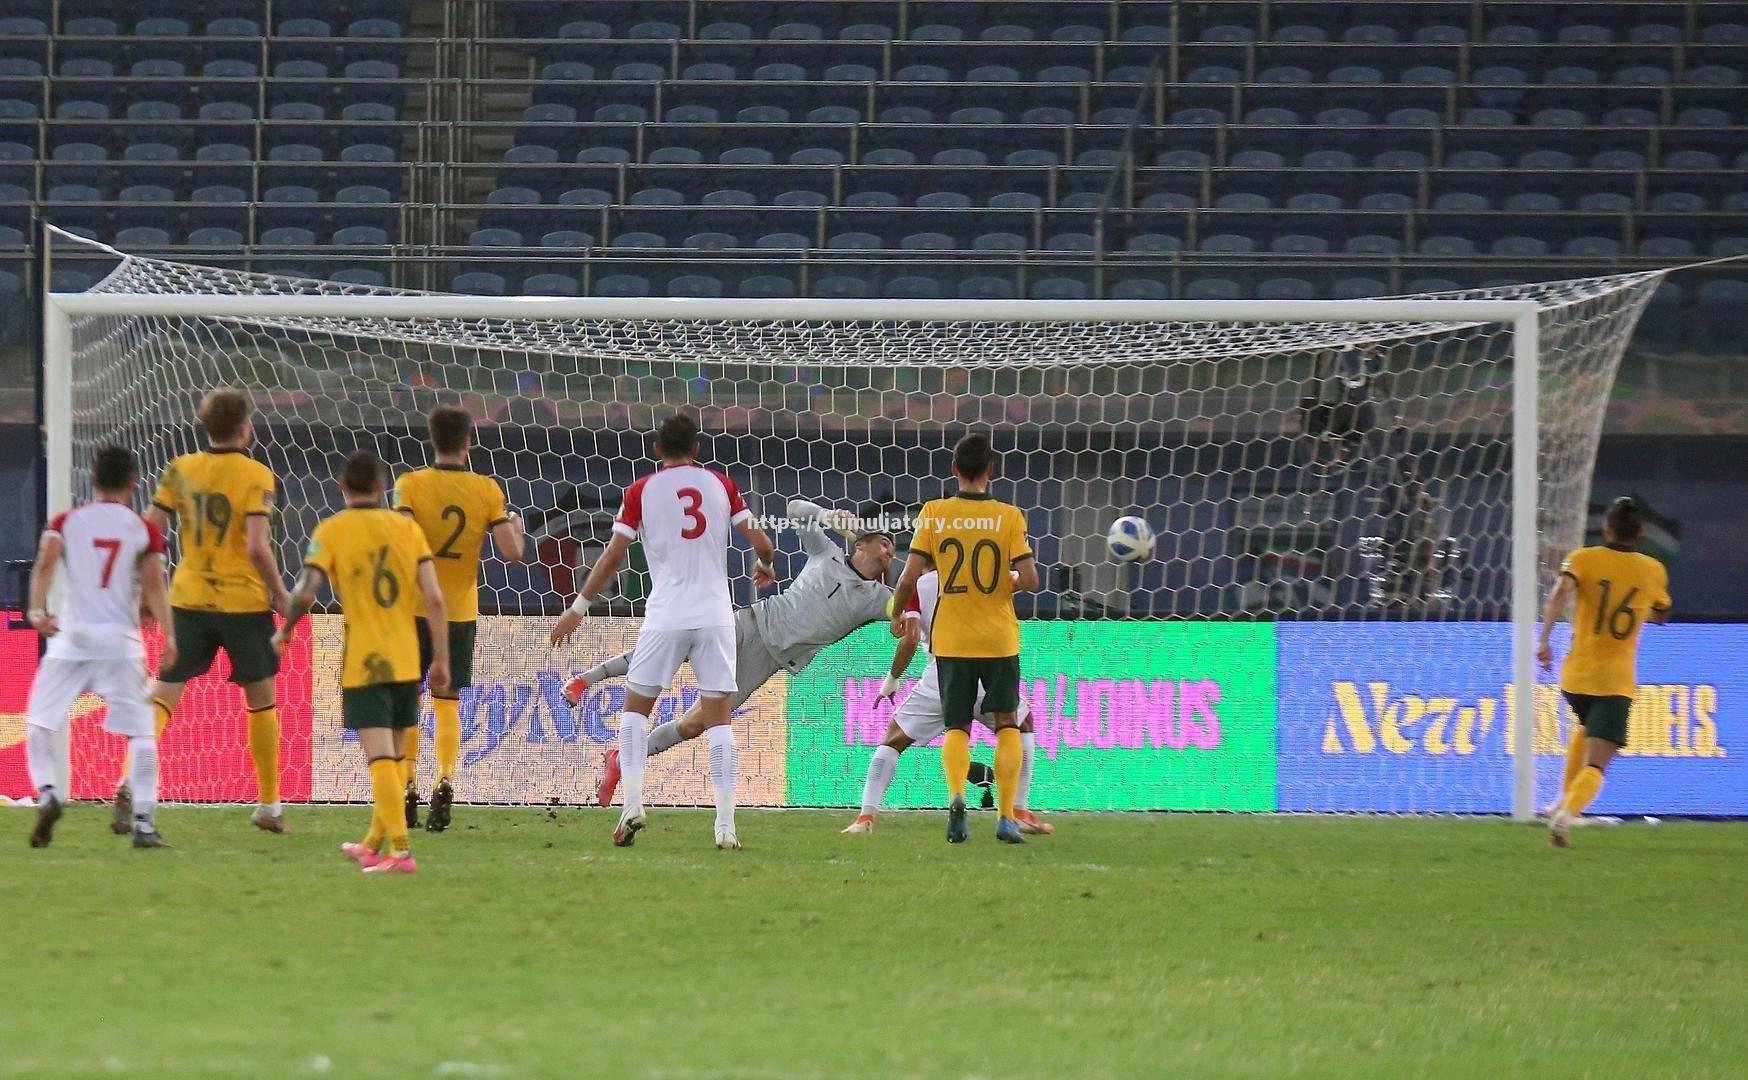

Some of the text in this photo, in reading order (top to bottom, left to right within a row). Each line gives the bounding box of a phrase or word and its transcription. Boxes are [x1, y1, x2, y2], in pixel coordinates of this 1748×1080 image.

[192, 490, 231, 547] 19
[434, 504, 466, 559] 2
[676, 487, 707, 540] 3
[93, 538, 122, 589] 7
[373, 543, 399, 609] 6
[827, 582, 842, 599] 1
[939, 537, 1001, 594] 20
[1594, 578, 1639, 640] 16
[1321, 681, 1498, 755] New
